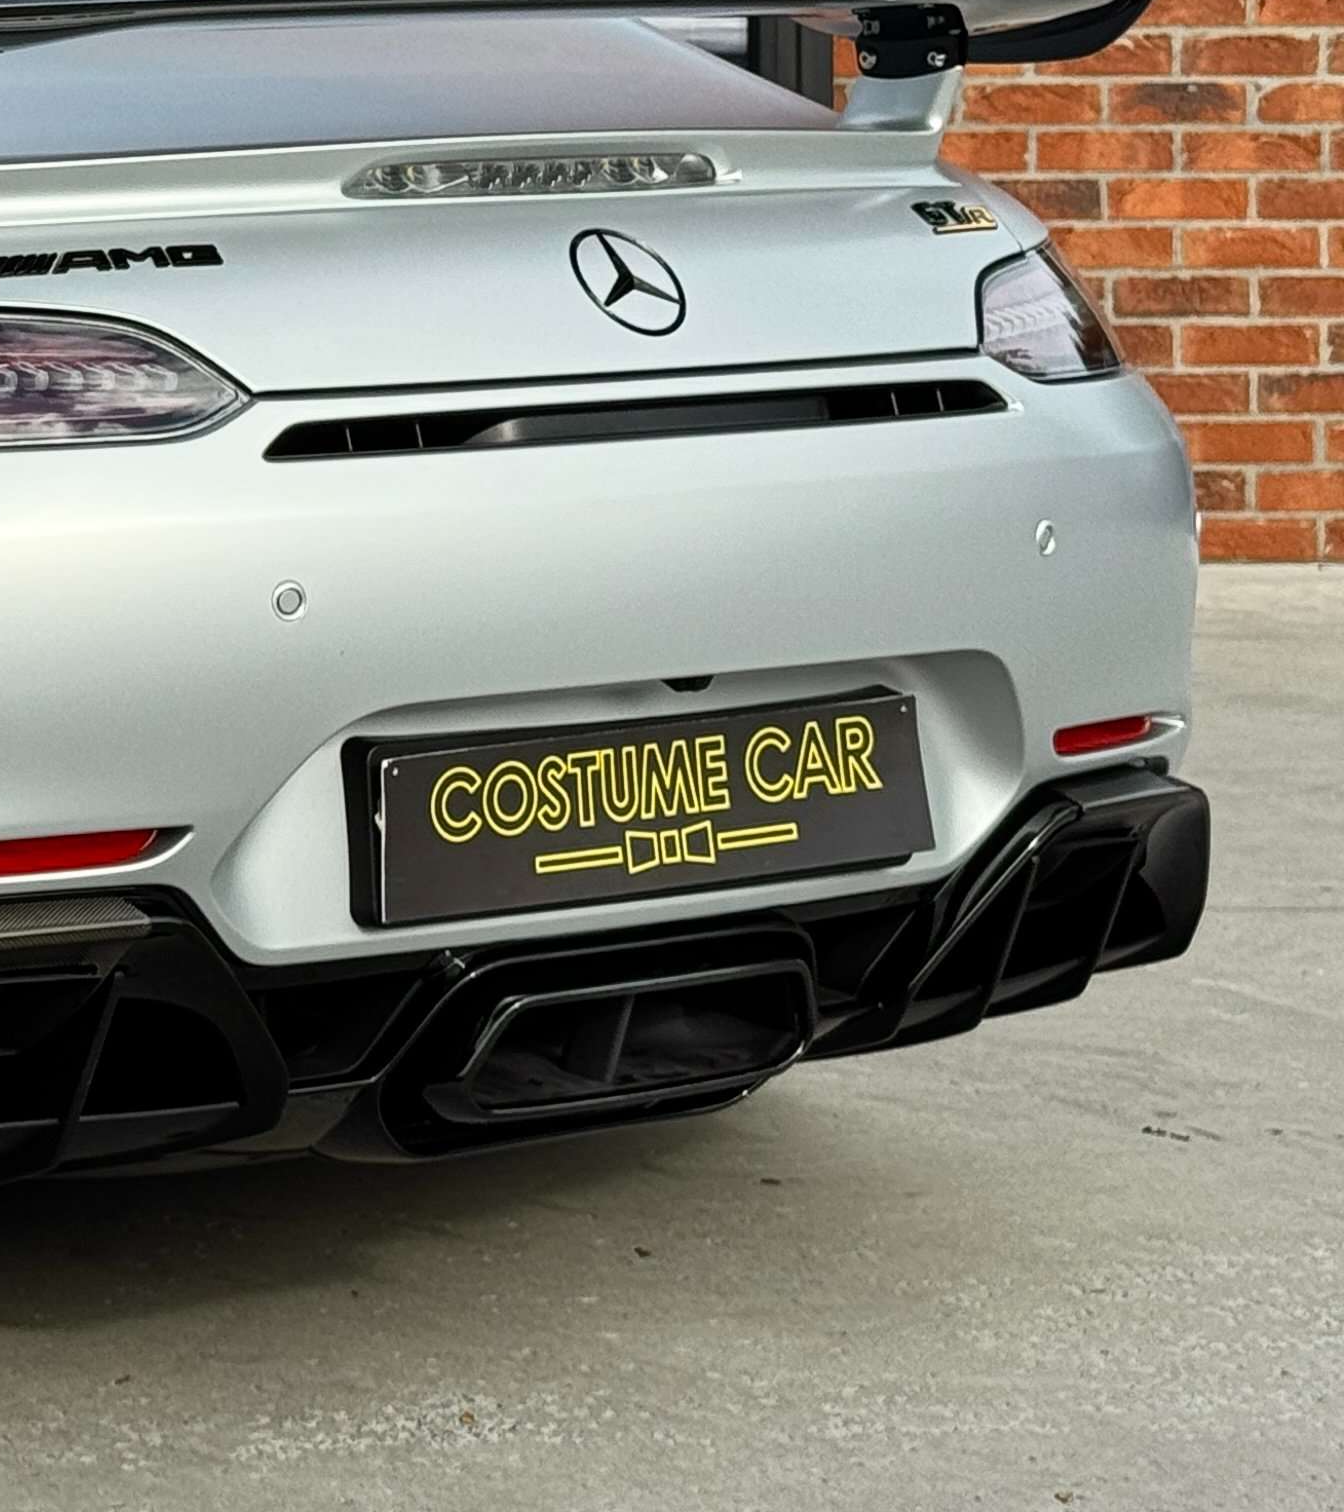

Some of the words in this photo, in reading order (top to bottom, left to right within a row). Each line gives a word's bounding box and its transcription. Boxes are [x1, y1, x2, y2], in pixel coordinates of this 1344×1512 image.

[52, 244, 224, 274] AMG
[430, 734, 732, 842] COSTUME
[744, 716, 883, 803] CAR
